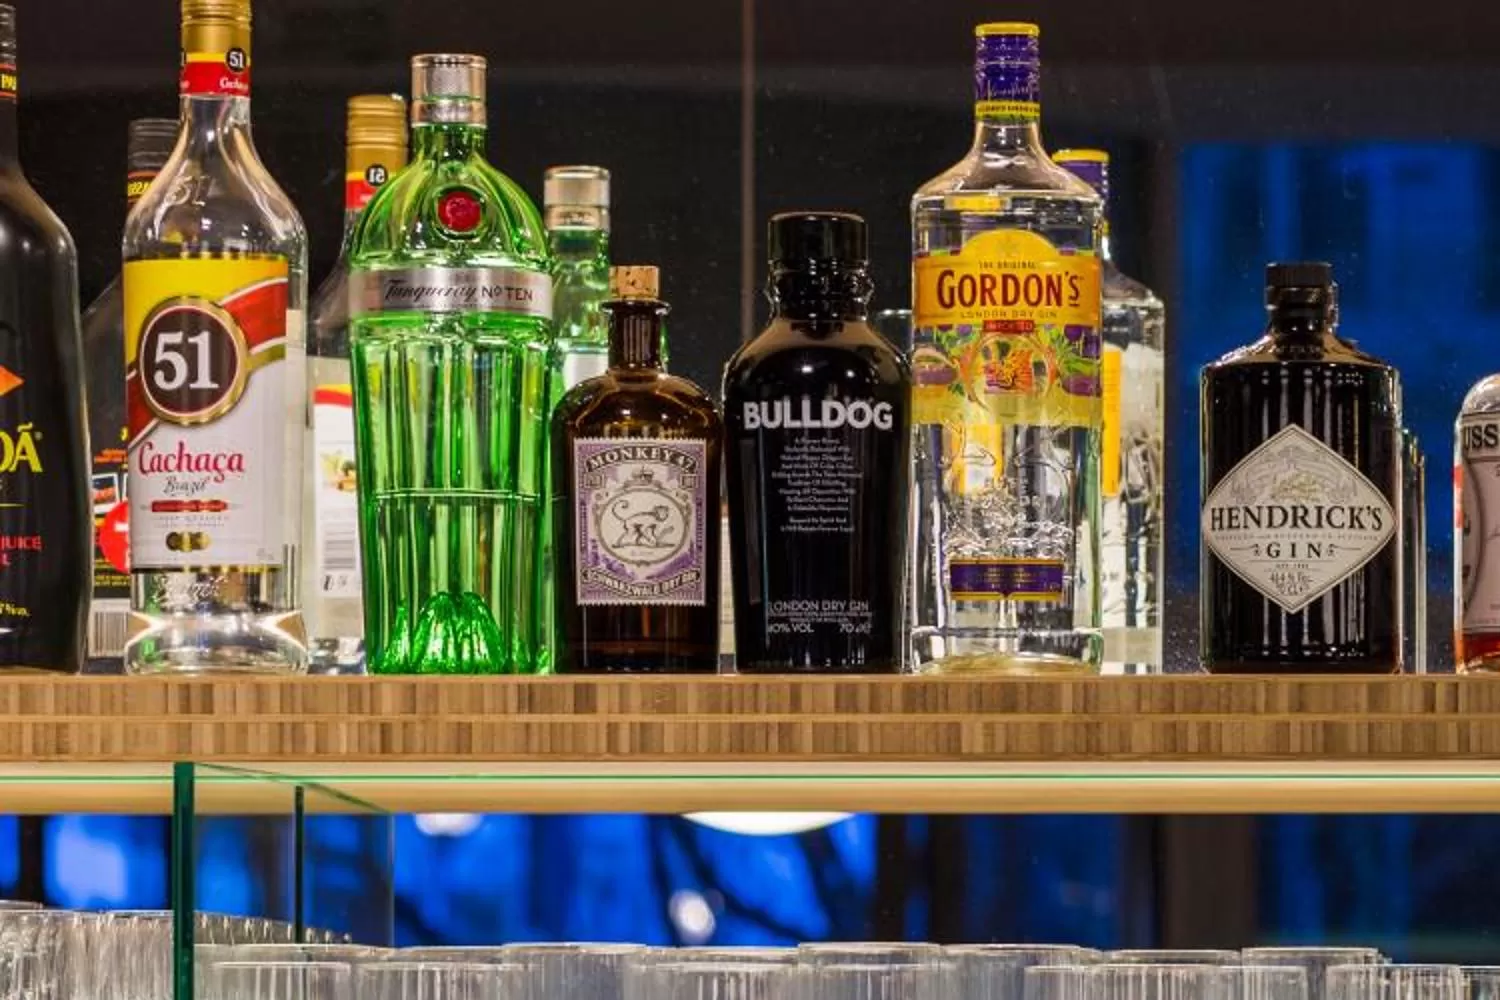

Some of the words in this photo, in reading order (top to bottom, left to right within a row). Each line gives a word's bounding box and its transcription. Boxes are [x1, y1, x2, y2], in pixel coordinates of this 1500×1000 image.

[228, 51, 245, 69] 51
[384, 280, 476, 301] Tanqueray
[506, 287, 533, 301] TEN
[937, 270, 1081, 309] GORDON'S
[1011, 311, 1034, 319] DRY
[153, 330, 219, 391] 51
[743, 400, 894, 430] BULLDOG
[138, 440, 246, 482] Cachaça
[587, 447, 674, 472] MONKEY
[677, 453, 696, 473] 47
[1210, 505, 1384, 531] HENDRICK'S
[1266, 541, 1323, 559] GIN
[821, 600, 847, 611] DRY
